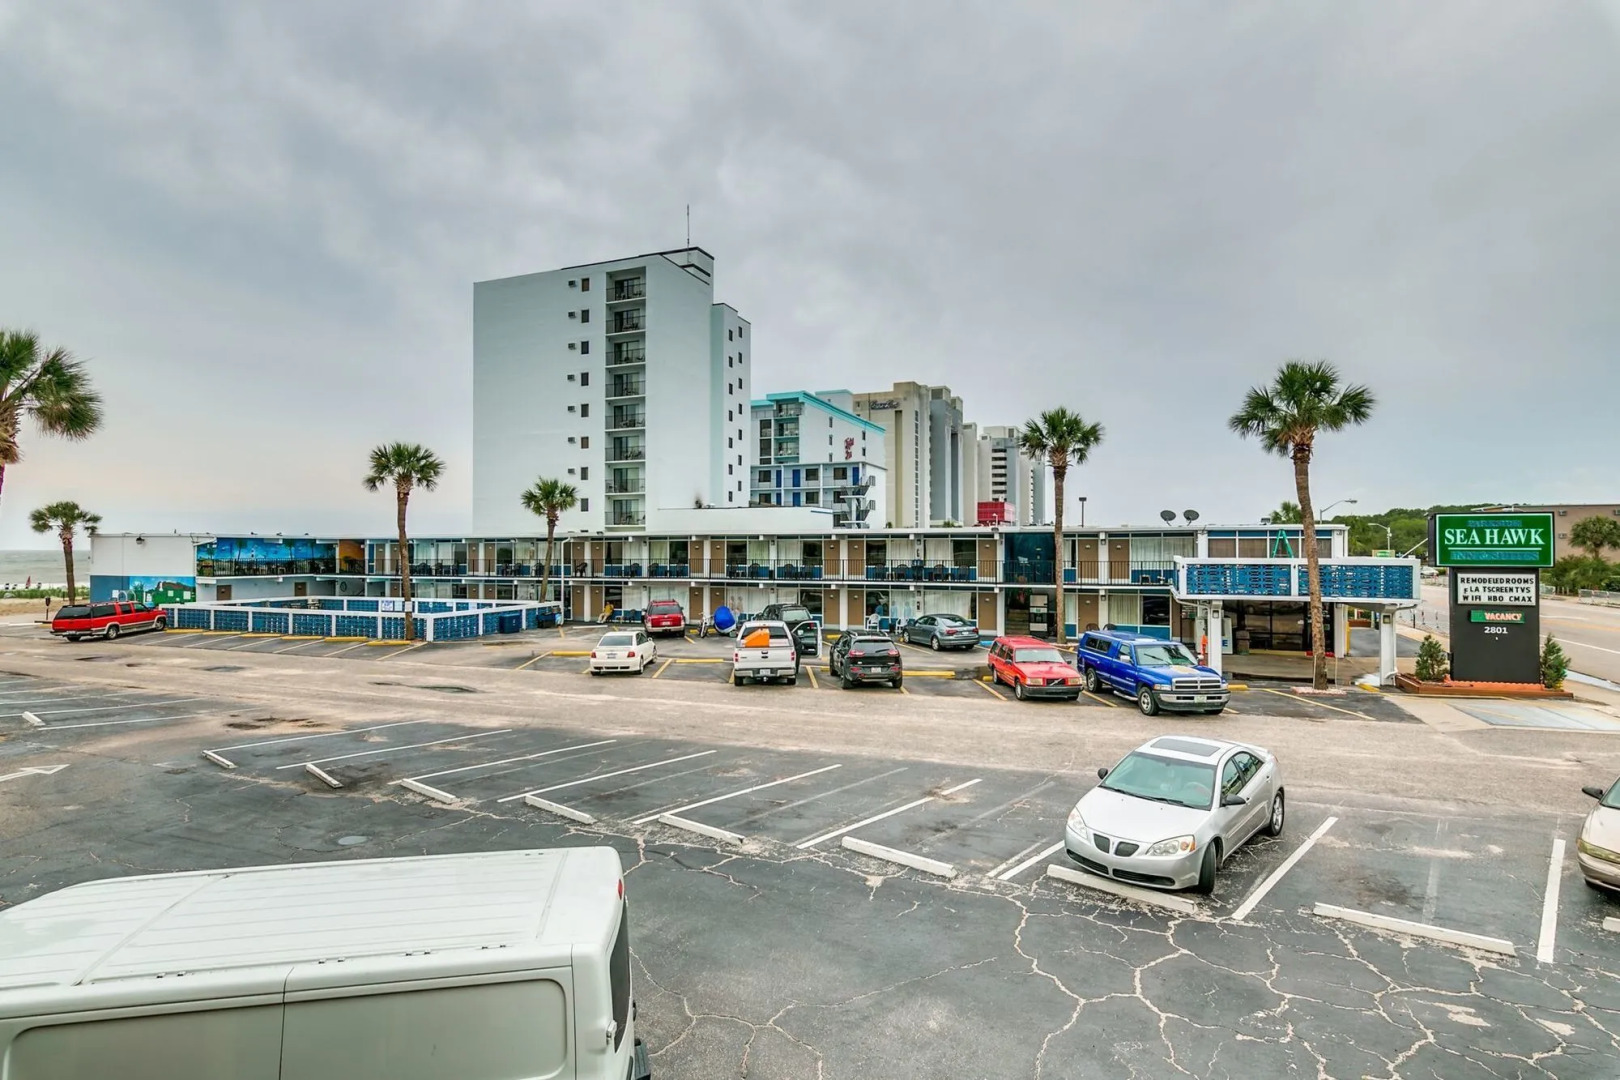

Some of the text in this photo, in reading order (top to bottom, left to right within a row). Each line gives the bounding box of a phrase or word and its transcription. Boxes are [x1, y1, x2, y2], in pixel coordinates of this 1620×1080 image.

[1444, 528, 1545, 545] SEA HAWK
[1484, 612, 1522, 621] VACANCY
[1484, 626, 1508, 634] 2801
